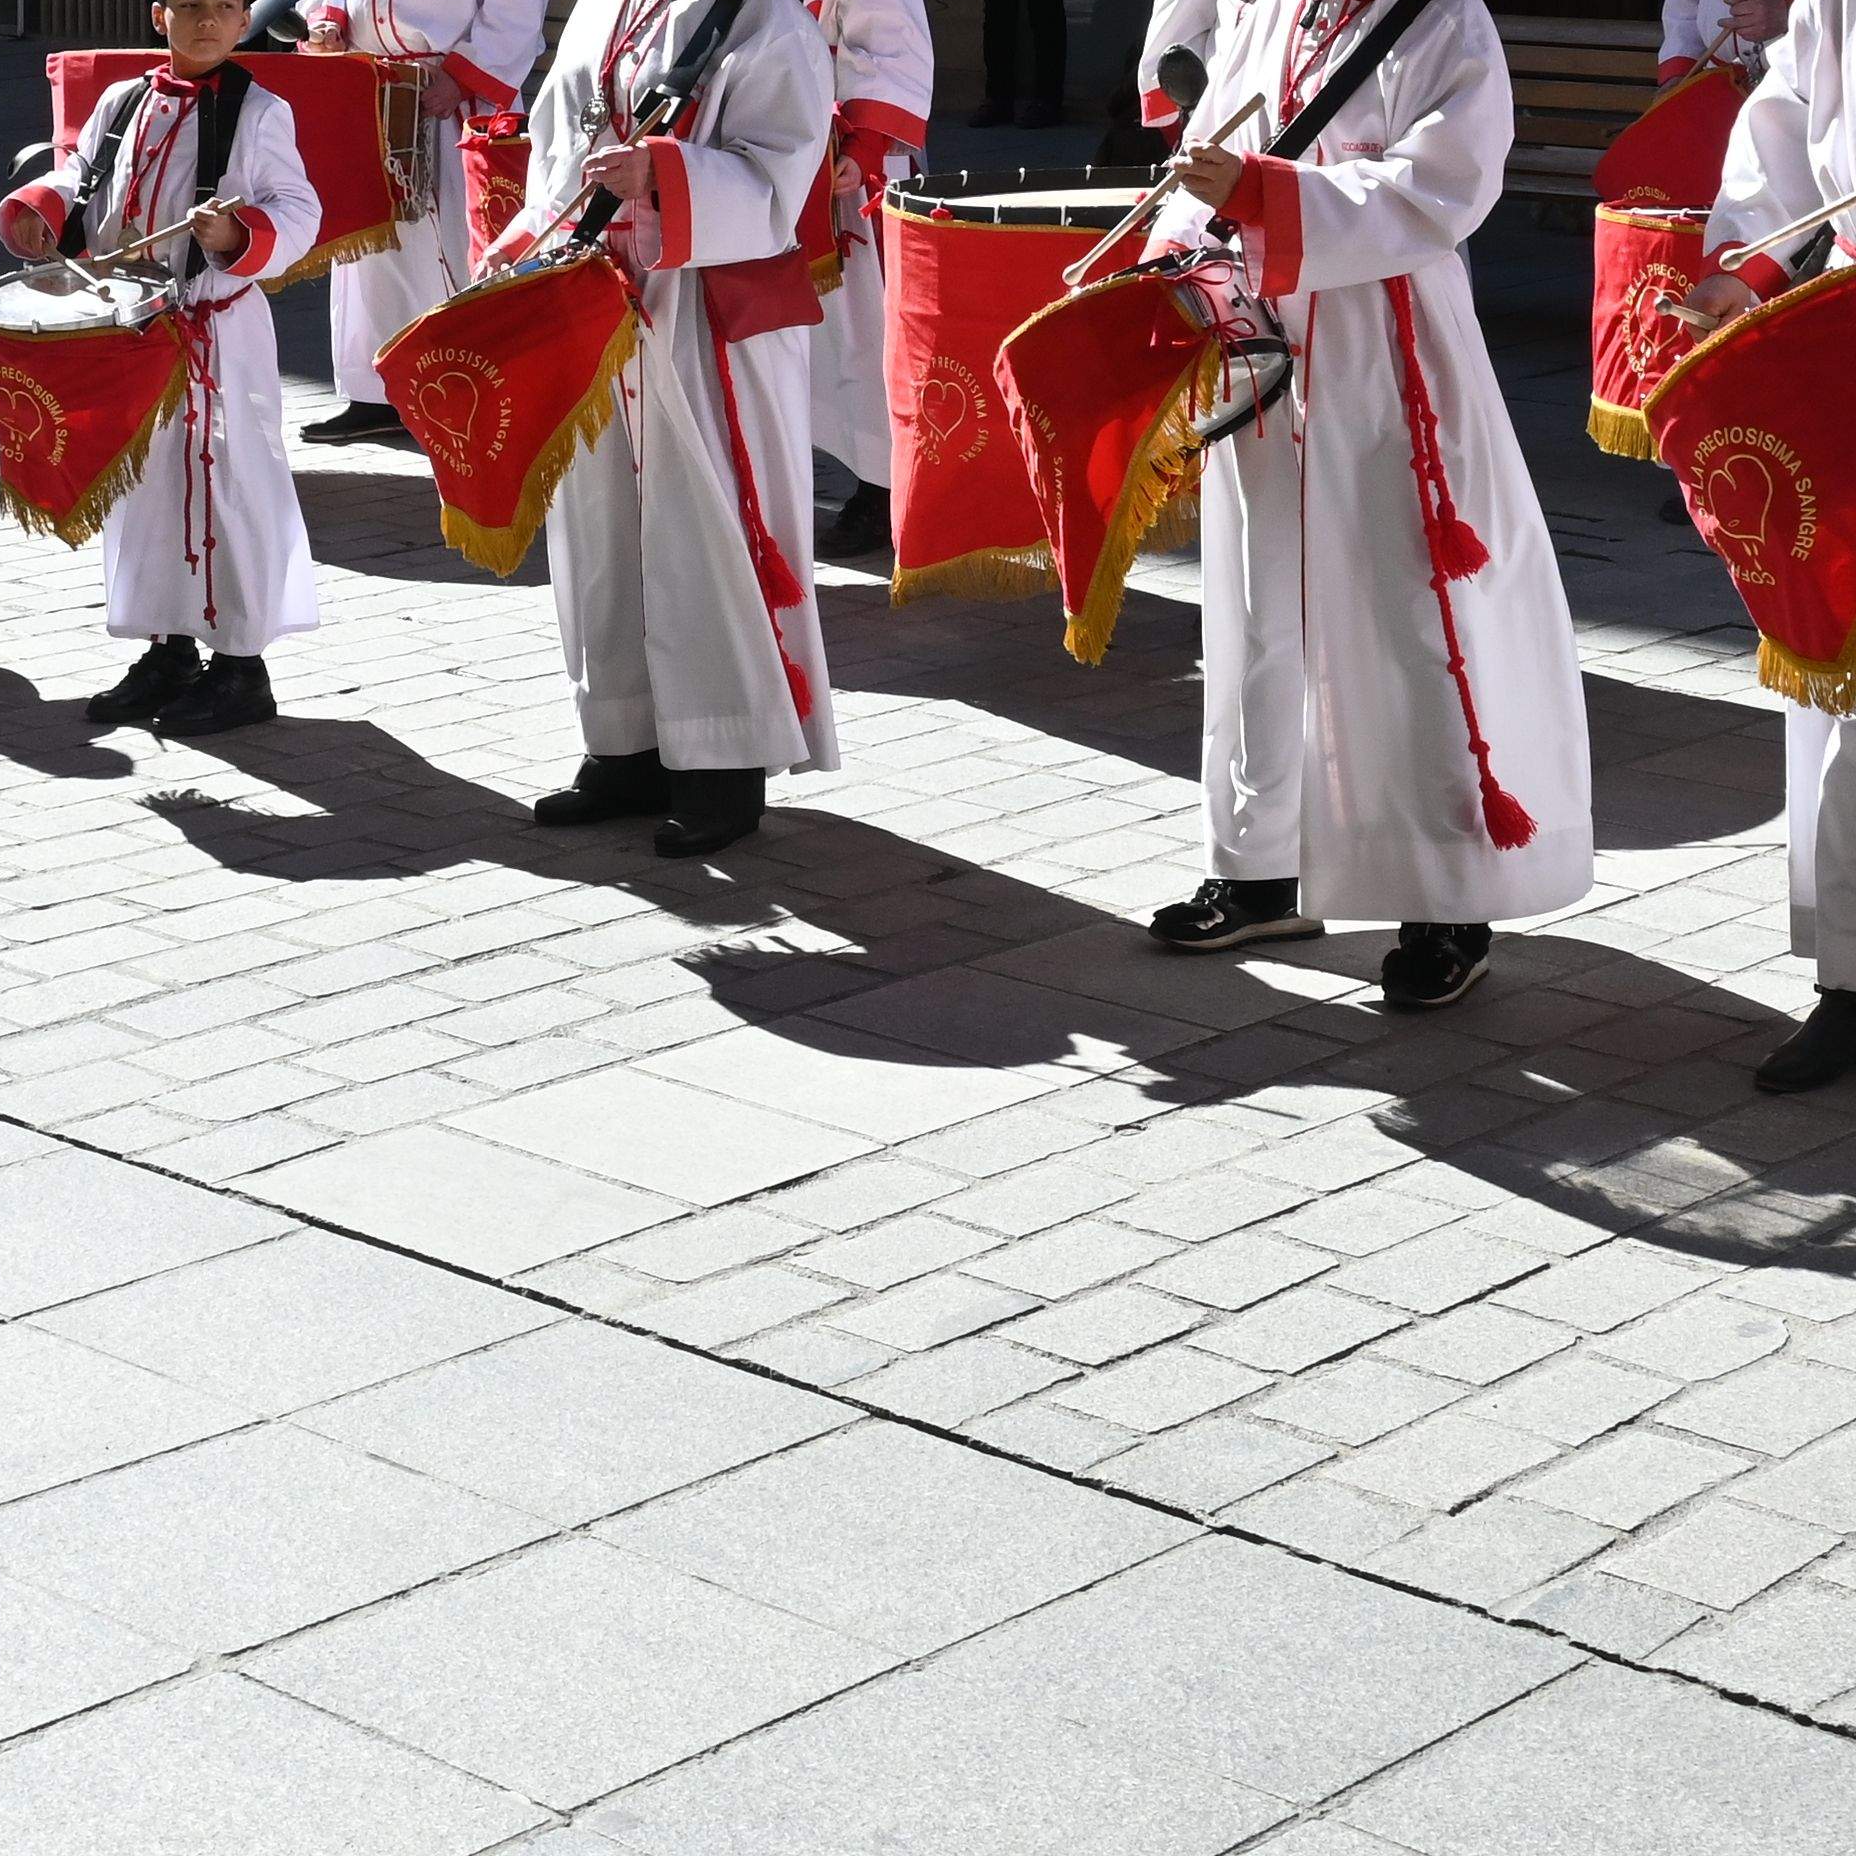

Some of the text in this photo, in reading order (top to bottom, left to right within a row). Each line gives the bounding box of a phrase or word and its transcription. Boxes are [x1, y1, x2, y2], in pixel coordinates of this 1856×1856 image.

[415, 347, 506, 389] PRECIOSISIMA
[486, 396, 513, 461] SANGRE
[931, 356, 988, 419] PRECIOSISIMA
[958, 427, 990, 463] SANGRE
[1694, 425, 1802, 477] PRECIOSISIMA
[1690, 465, 1705, 490] LA
[1790, 476, 1817, 562] SANGRE
